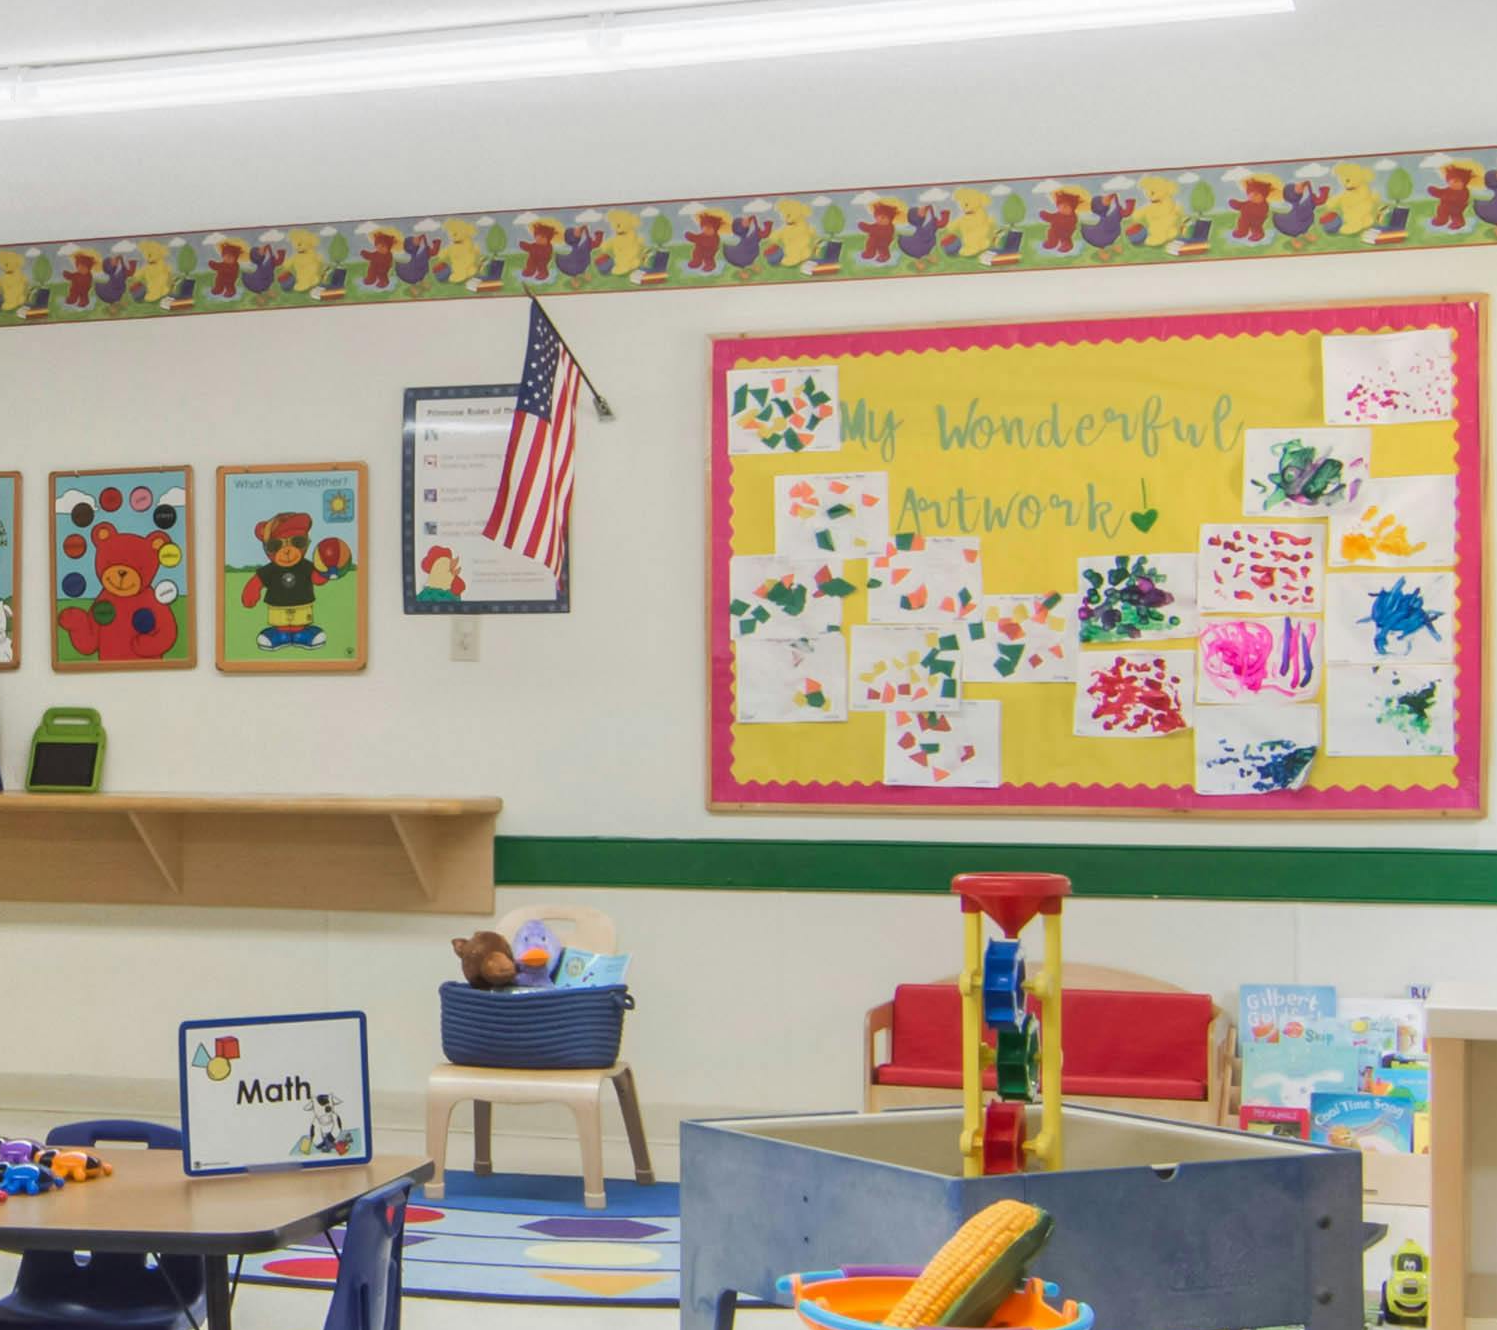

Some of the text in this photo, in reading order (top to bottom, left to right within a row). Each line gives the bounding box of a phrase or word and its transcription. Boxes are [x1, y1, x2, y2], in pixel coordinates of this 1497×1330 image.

[839, 392, 1248, 463] My Wonderful
[234, 477, 348, 489] What is the Weather?
[1246, 986, 1320, 1012] Gilbert
[236, 1075, 311, 1105] Math
[1342, 1097, 1373, 1112] Time
